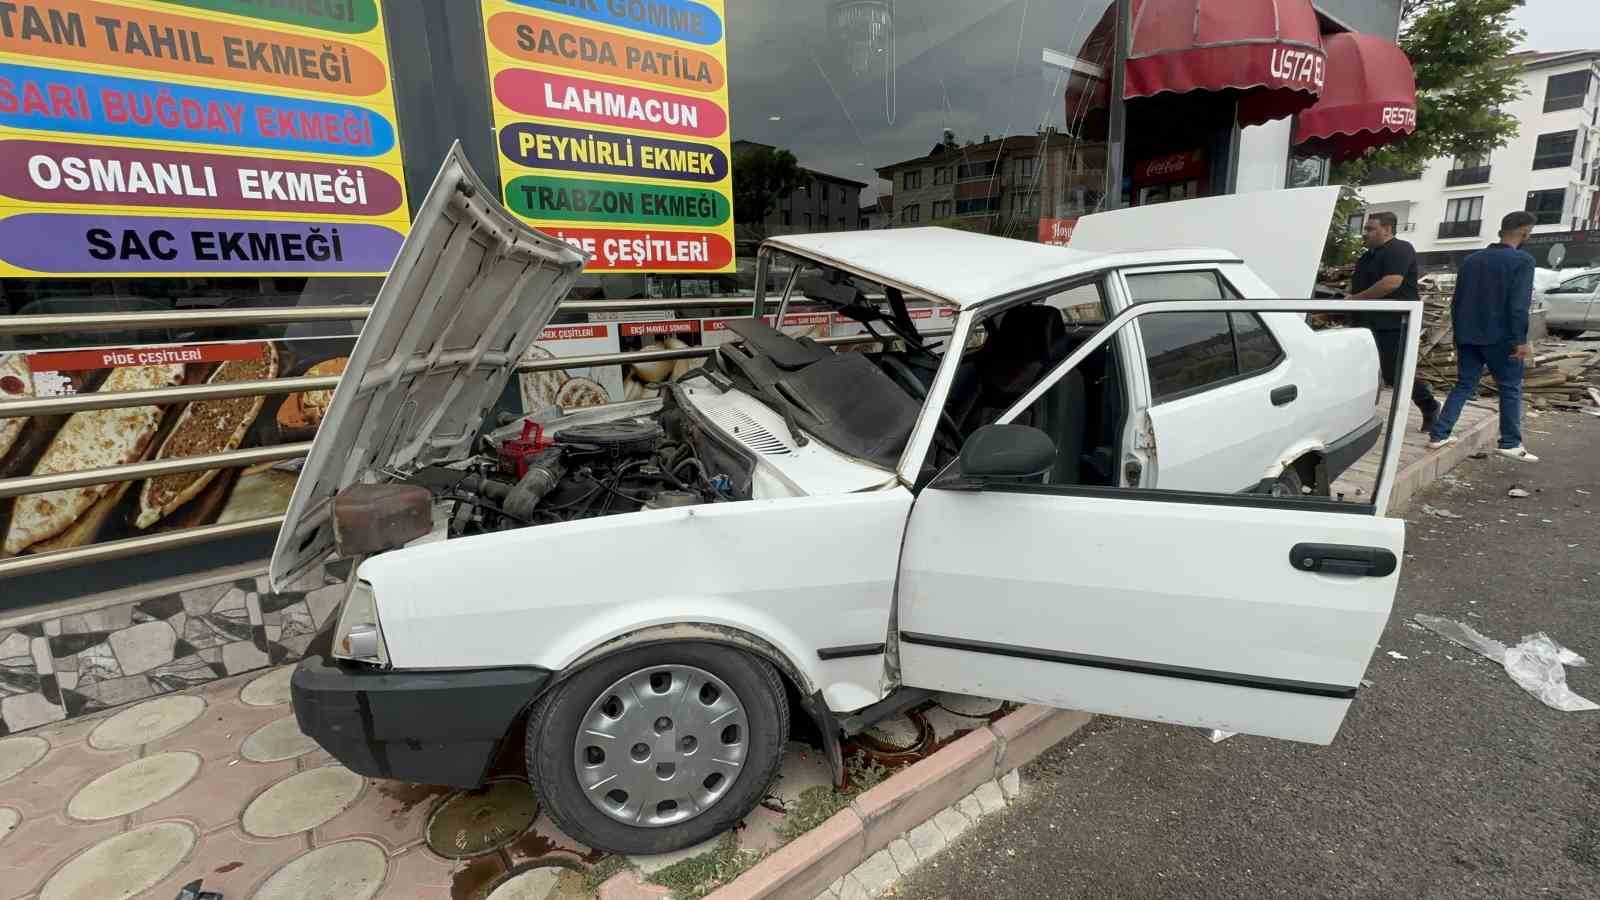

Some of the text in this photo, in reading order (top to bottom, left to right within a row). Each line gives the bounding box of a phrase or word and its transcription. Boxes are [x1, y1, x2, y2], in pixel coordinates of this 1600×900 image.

[0, 2, 353, 84] TAM TAHIL EKMEĞİ
[515, 23, 713, 84] SACDA PATİLA
[1270, 48, 1313, 83] USTA
[0, 77, 374, 146] SARI BUĞDAY EKMEĞİ
[543, 82, 699, 129] LAHMACUN
[518, 130, 716, 176] PEYNİRLİ EKMEK
[27, 154, 368, 206] OSMANLI EKMEĞİ
[520, 185, 719, 219] TRABZON EKMEĞİ
[85, 227, 343, 263] SAC EKMEĞİ
[602, 234, 709, 267] ÇEŞİTLERİ
[102, 348, 202, 366] PİDE ÇEŞİTLERİ
